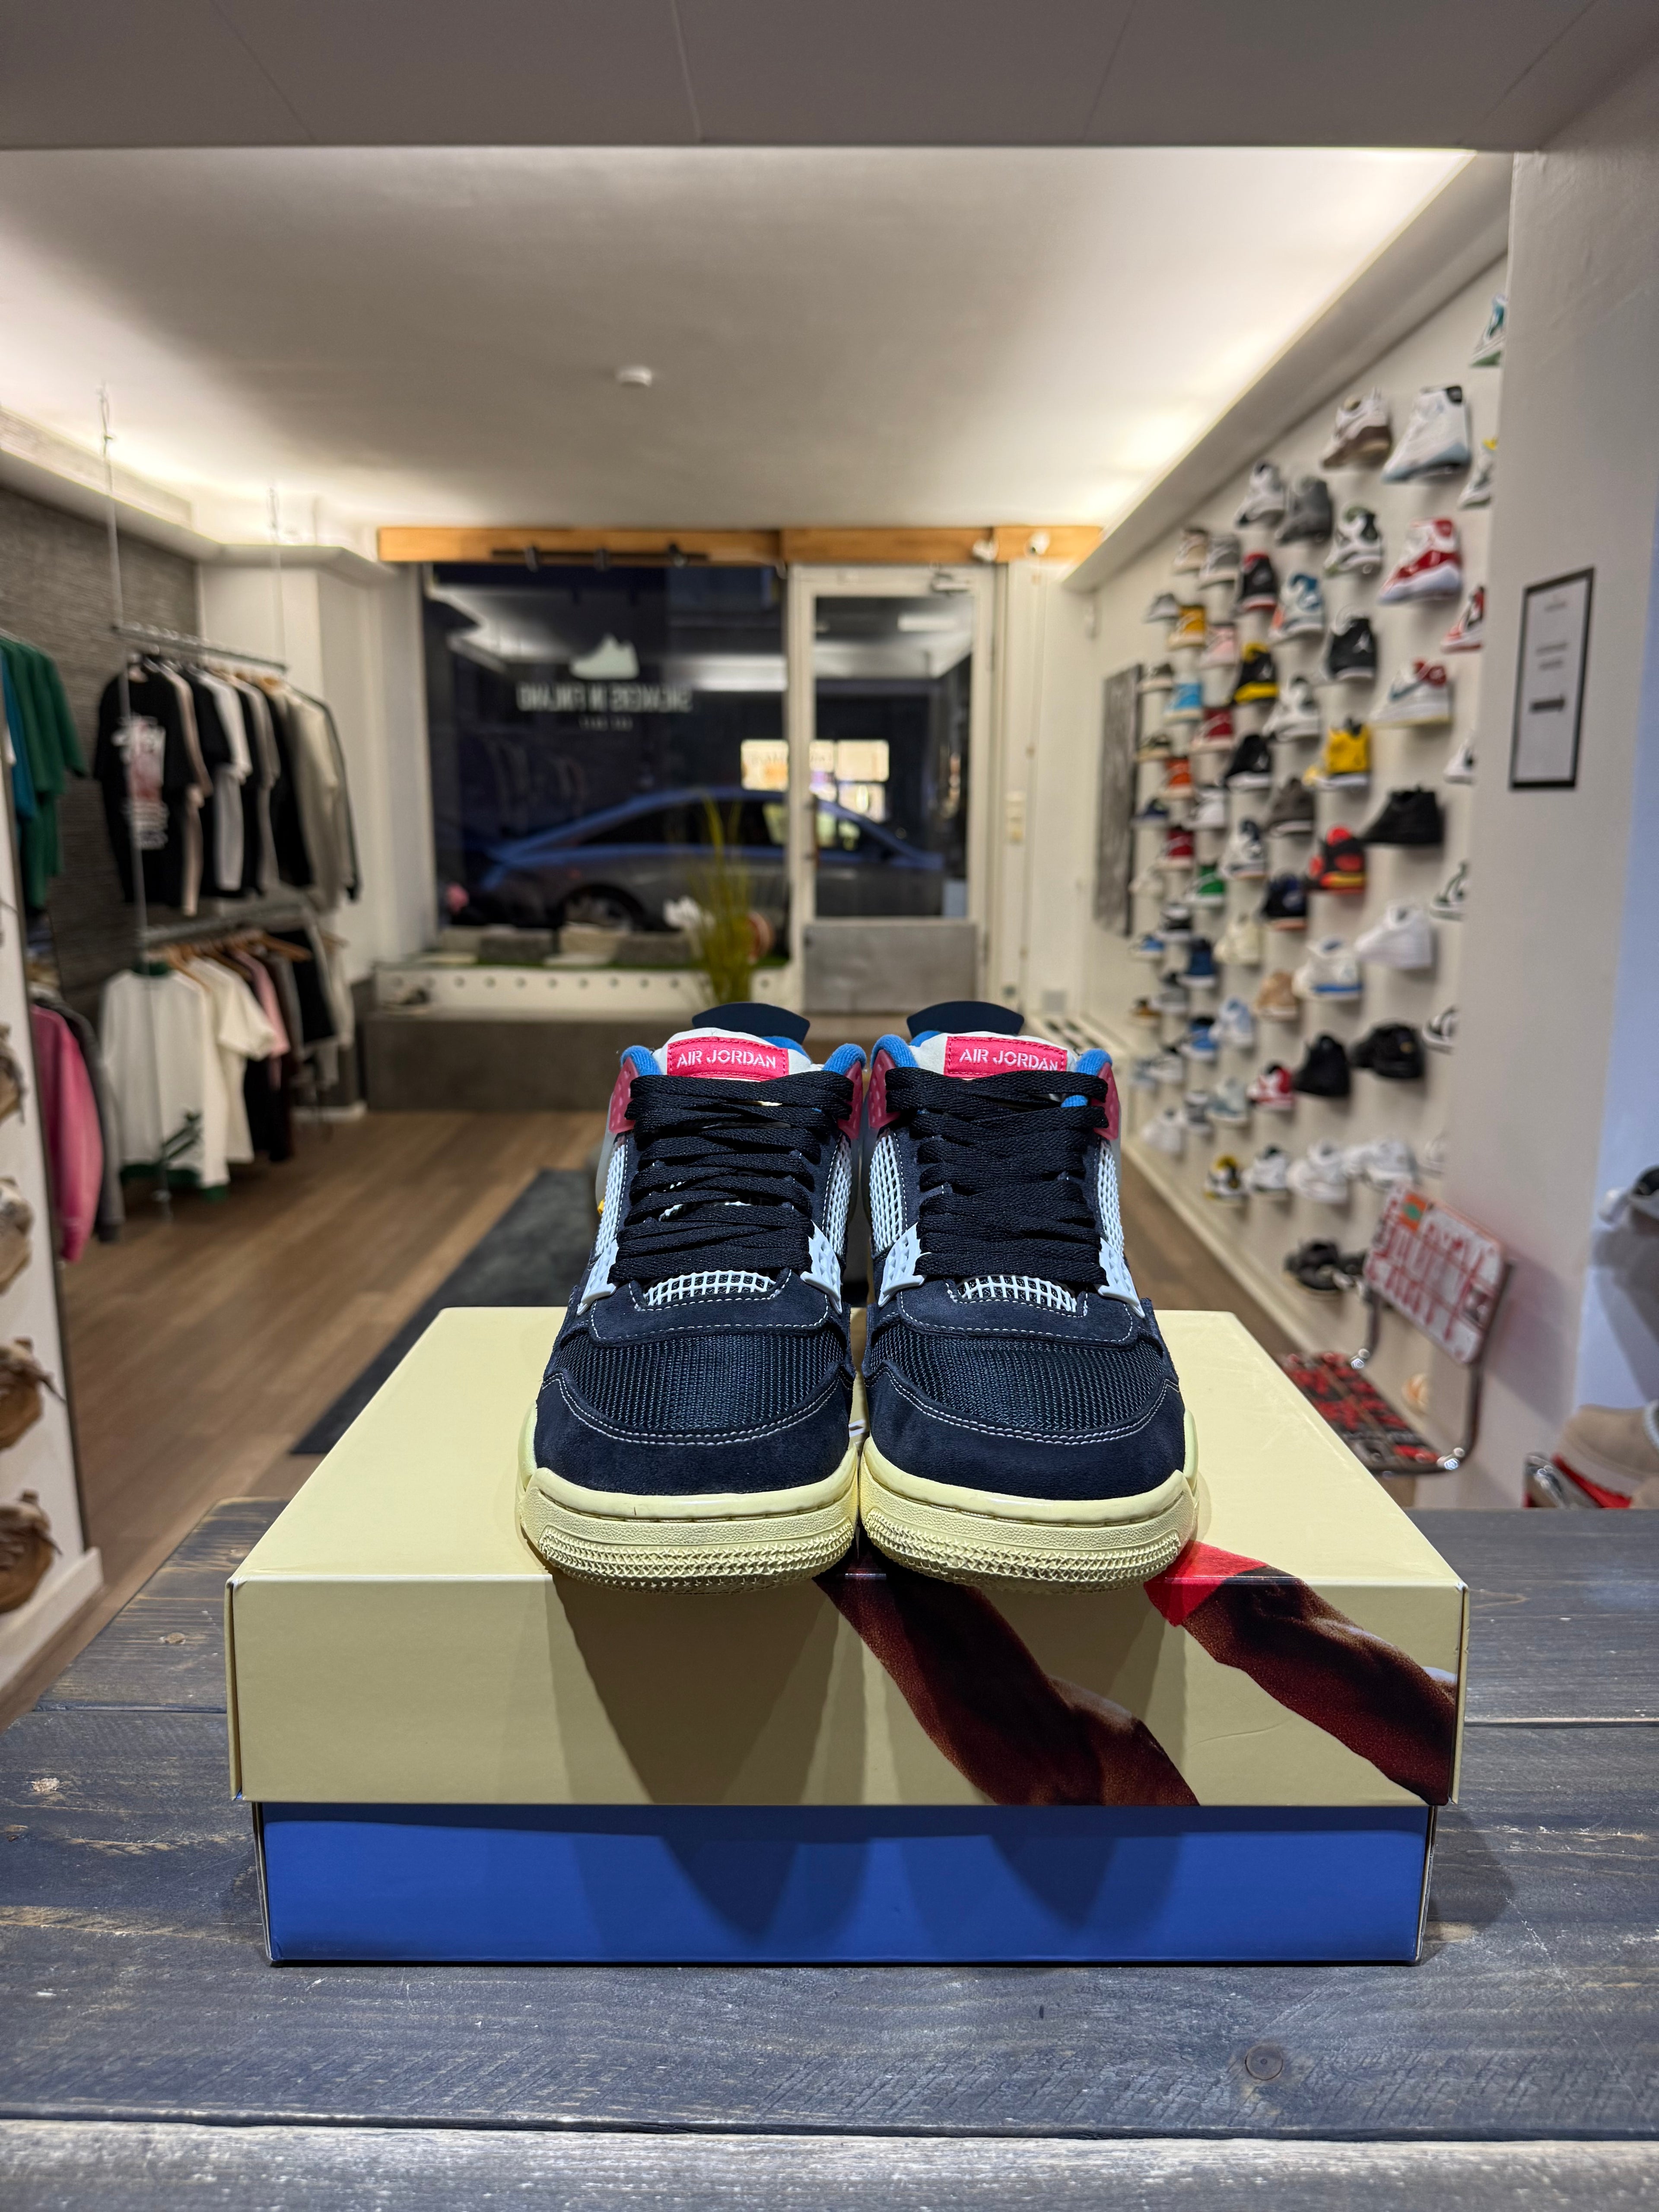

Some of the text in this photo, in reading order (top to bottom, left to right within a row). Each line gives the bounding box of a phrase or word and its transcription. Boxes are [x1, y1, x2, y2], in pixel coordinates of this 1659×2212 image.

[677, 1049, 776, 1069] AIR JORDAN
[959, 1048, 1058, 1071] AIR JORDAN
